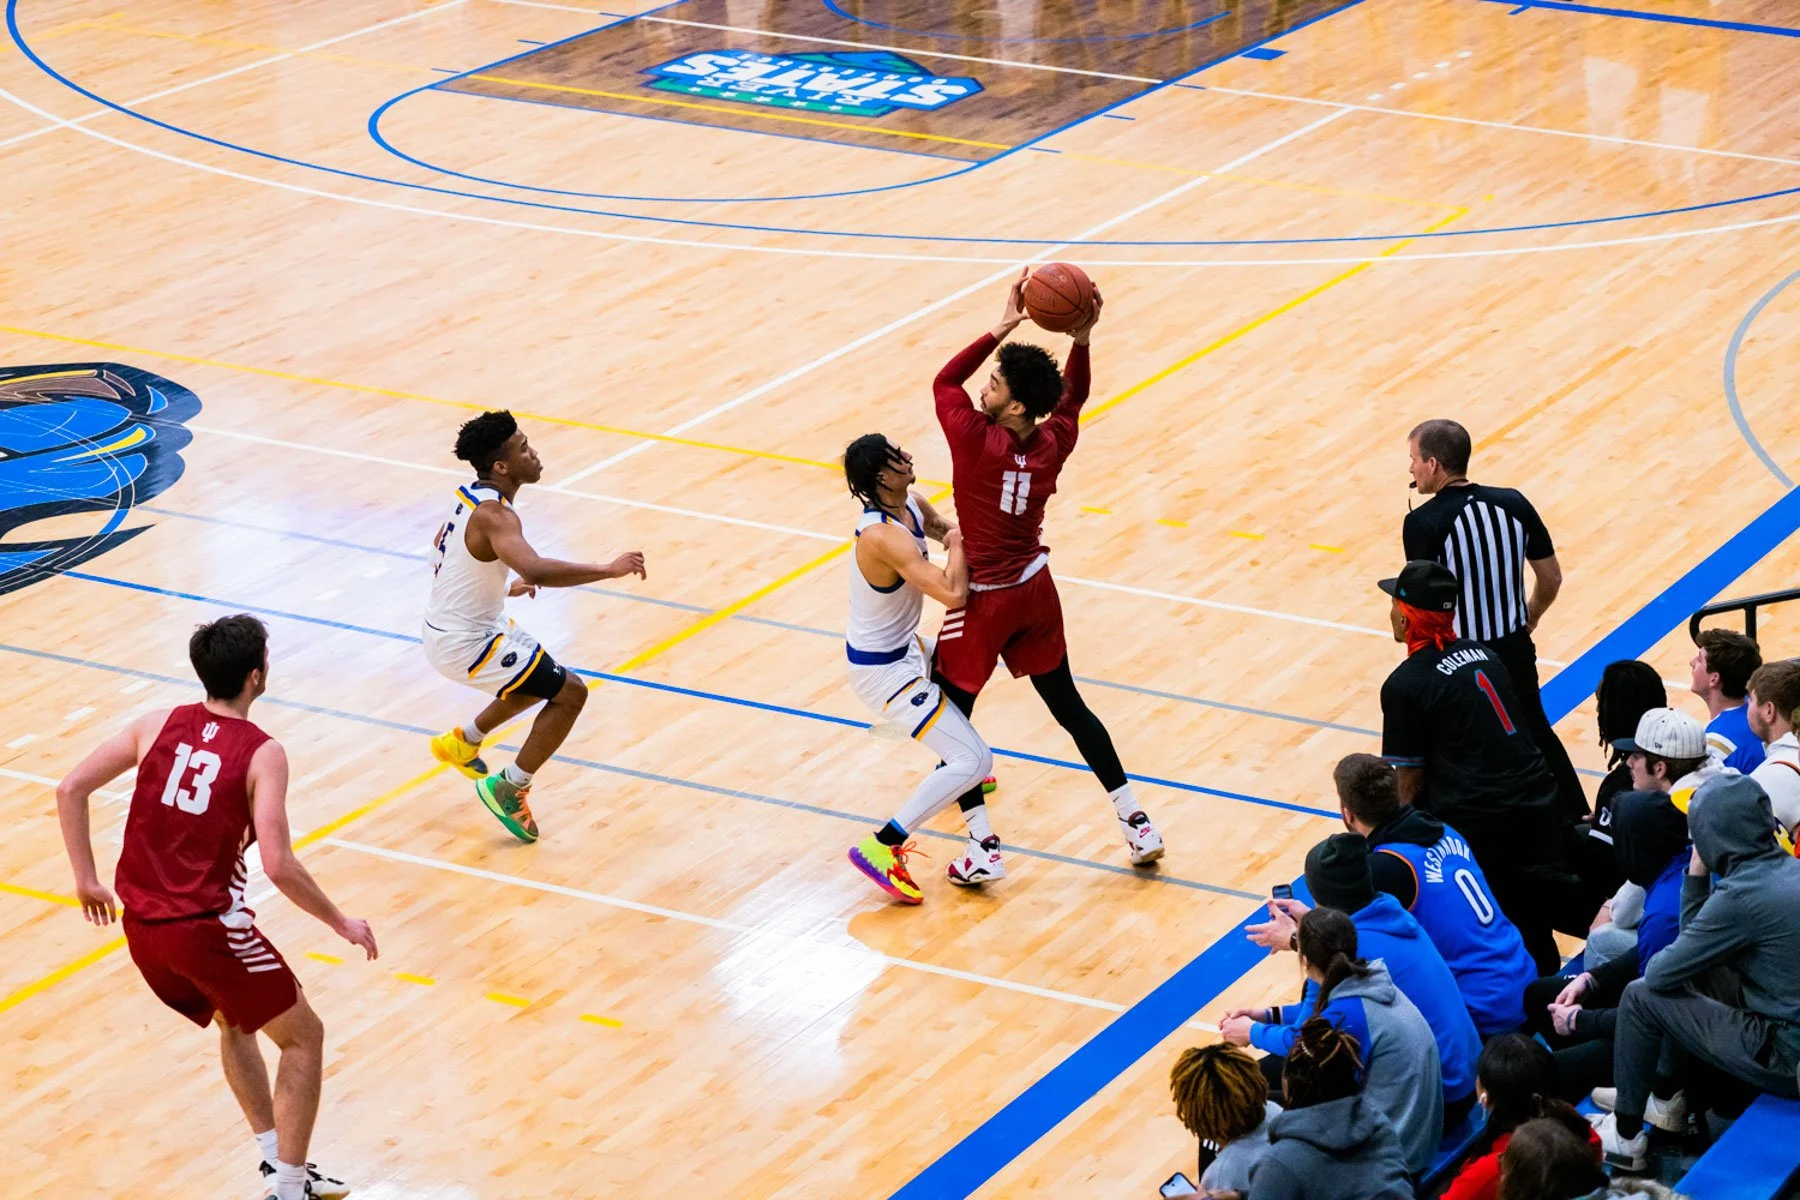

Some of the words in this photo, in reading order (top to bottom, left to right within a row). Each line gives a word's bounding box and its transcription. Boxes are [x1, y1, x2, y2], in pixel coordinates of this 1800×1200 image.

[662, 54, 968, 106] STATES
[696, 75, 873, 106] RIVER
[1000, 470, 1032, 516] 11
[1436, 648, 1489, 676] COLEMAN
[1474, 669, 1517, 736] 1
[160, 742, 222, 815] 13
[1454, 868, 1494, 925] 0
